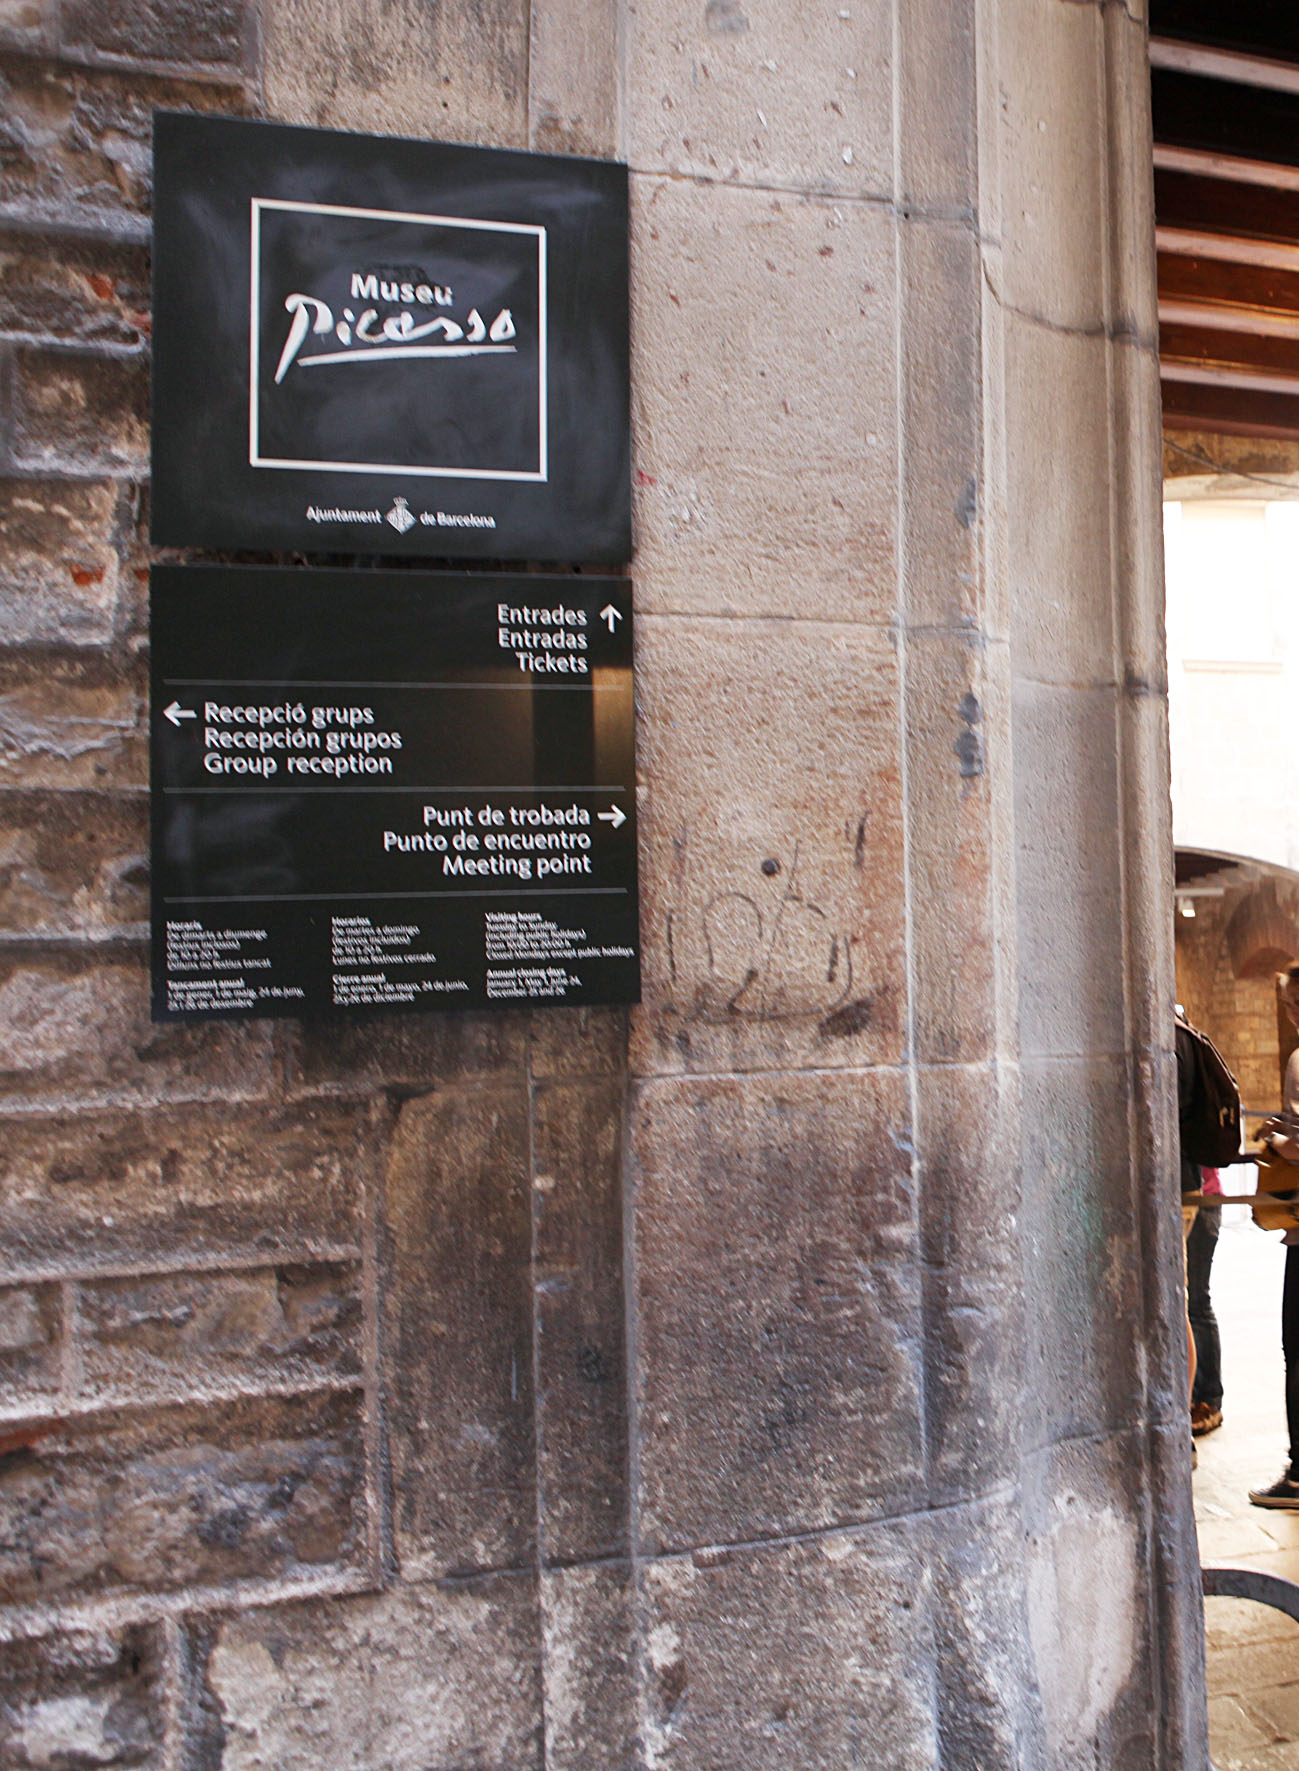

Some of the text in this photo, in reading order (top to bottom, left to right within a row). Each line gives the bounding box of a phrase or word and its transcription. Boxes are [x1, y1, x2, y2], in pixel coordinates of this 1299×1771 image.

[350, 273, 454, 306] Museu
[274, 293, 517, 385] Picasso
[306, 505, 496, 529] Ajuntament de Barcelona
[497, 603, 589, 626] Entrades
[498, 627, 589, 650] Entradas
[515, 651, 589, 673] Tickets
[204, 701, 375, 730] Recepció grups
[204, 726, 403, 754] Recepción grupos
[203, 752, 393, 779] Group reception
[422, 803, 591, 827] Punt de trobada
[383, 829, 592, 852] Punto de encuentro
[442, 853, 592, 880] Meeting point
[332, 956, 358, 966] Lunes
